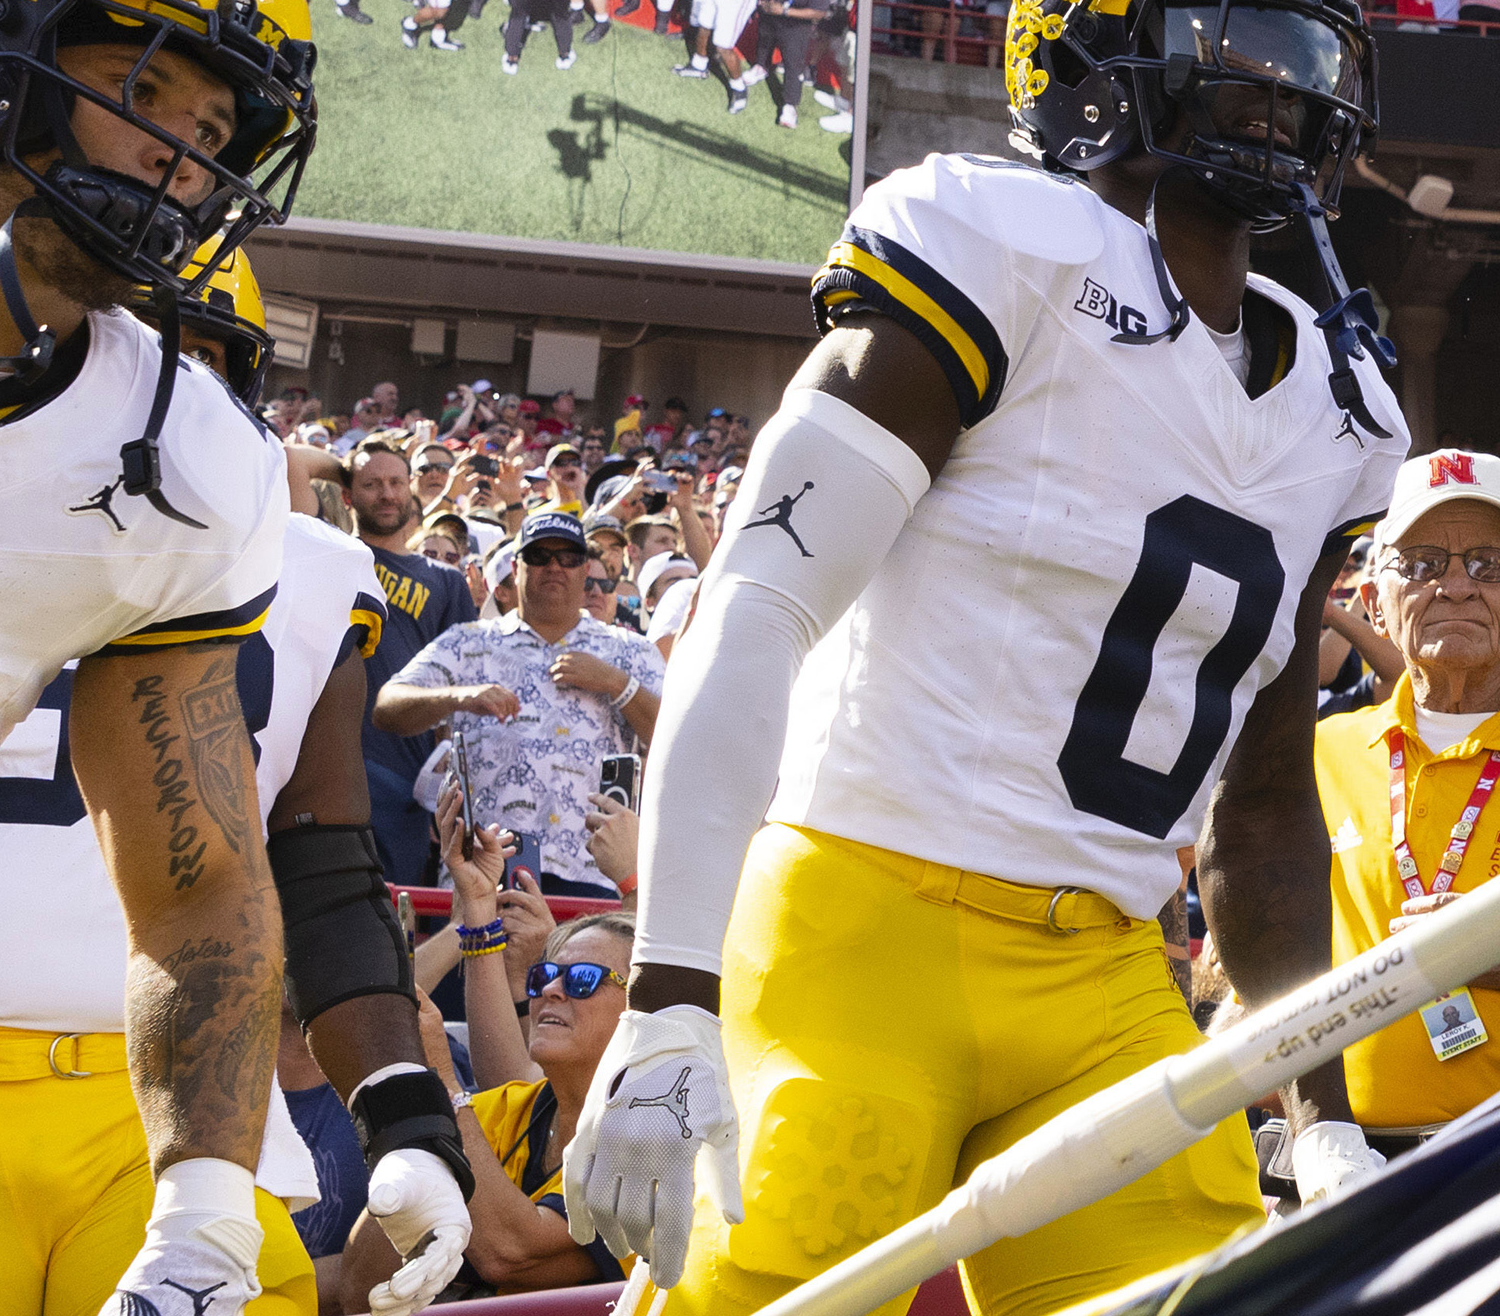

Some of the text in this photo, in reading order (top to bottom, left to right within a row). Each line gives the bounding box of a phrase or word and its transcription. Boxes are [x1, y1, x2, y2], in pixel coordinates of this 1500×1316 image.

[257, 18, 285, 52] M
[1428, 453, 1478, 488] N
[1059, 493, 1285, 840] 0
[1373, 948, 1404, 975] DO
[1307, 1013, 1346, 1047] end
[1442, 1044, 1463, 1057] EVENT
